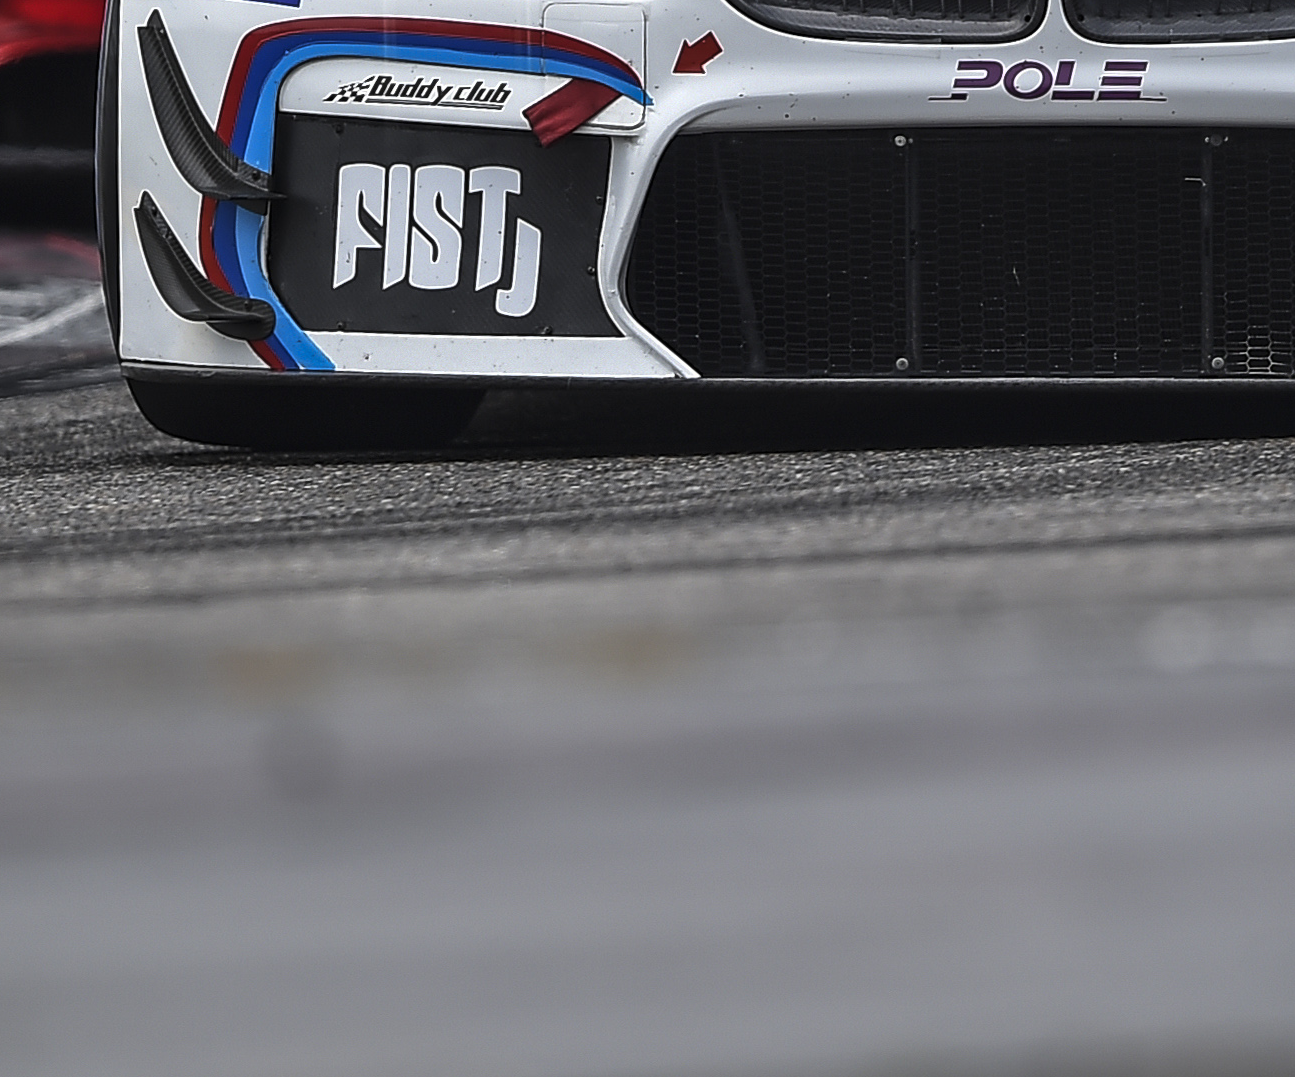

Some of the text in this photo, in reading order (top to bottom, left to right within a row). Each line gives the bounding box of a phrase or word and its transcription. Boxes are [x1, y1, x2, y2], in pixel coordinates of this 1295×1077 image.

[368, 76, 512, 106] Buddy club
[928, 60, 1167, 101] POLE
